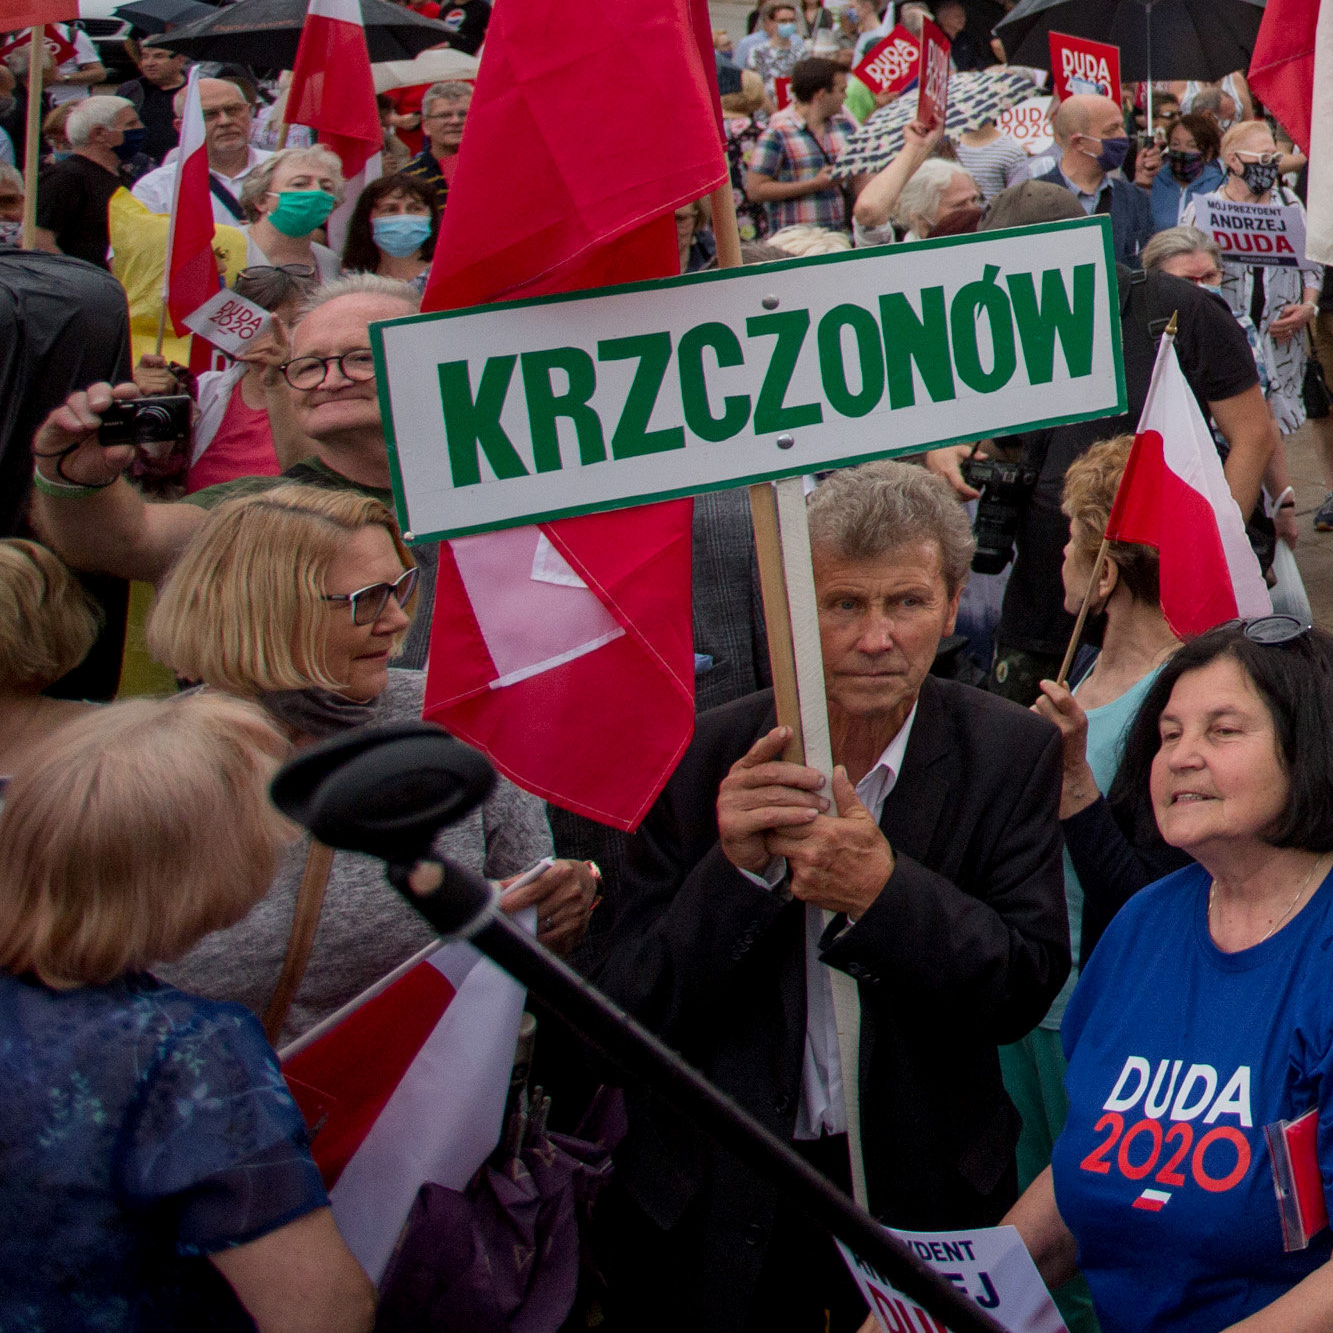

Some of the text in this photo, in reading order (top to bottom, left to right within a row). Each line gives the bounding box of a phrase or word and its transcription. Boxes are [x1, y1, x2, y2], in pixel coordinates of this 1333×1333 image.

[864, 38, 911, 83] DUDA
[879, 46, 919, 90] 2020
[1061, 48, 1111, 83] DUDA
[1210, 213, 1287, 232] ANDRZEJ
[1228, 204, 1282, 216] PREZYDENT
[1213, 231, 1296, 254] DUDA
[208, 310, 254, 339] 2020
[221, 300, 263, 330] DUDA
[1102, 1055, 1253, 1128] DUDA
[1079, 1112, 1252, 1193] 2020
[907, 1239, 976, 1262] DENT
